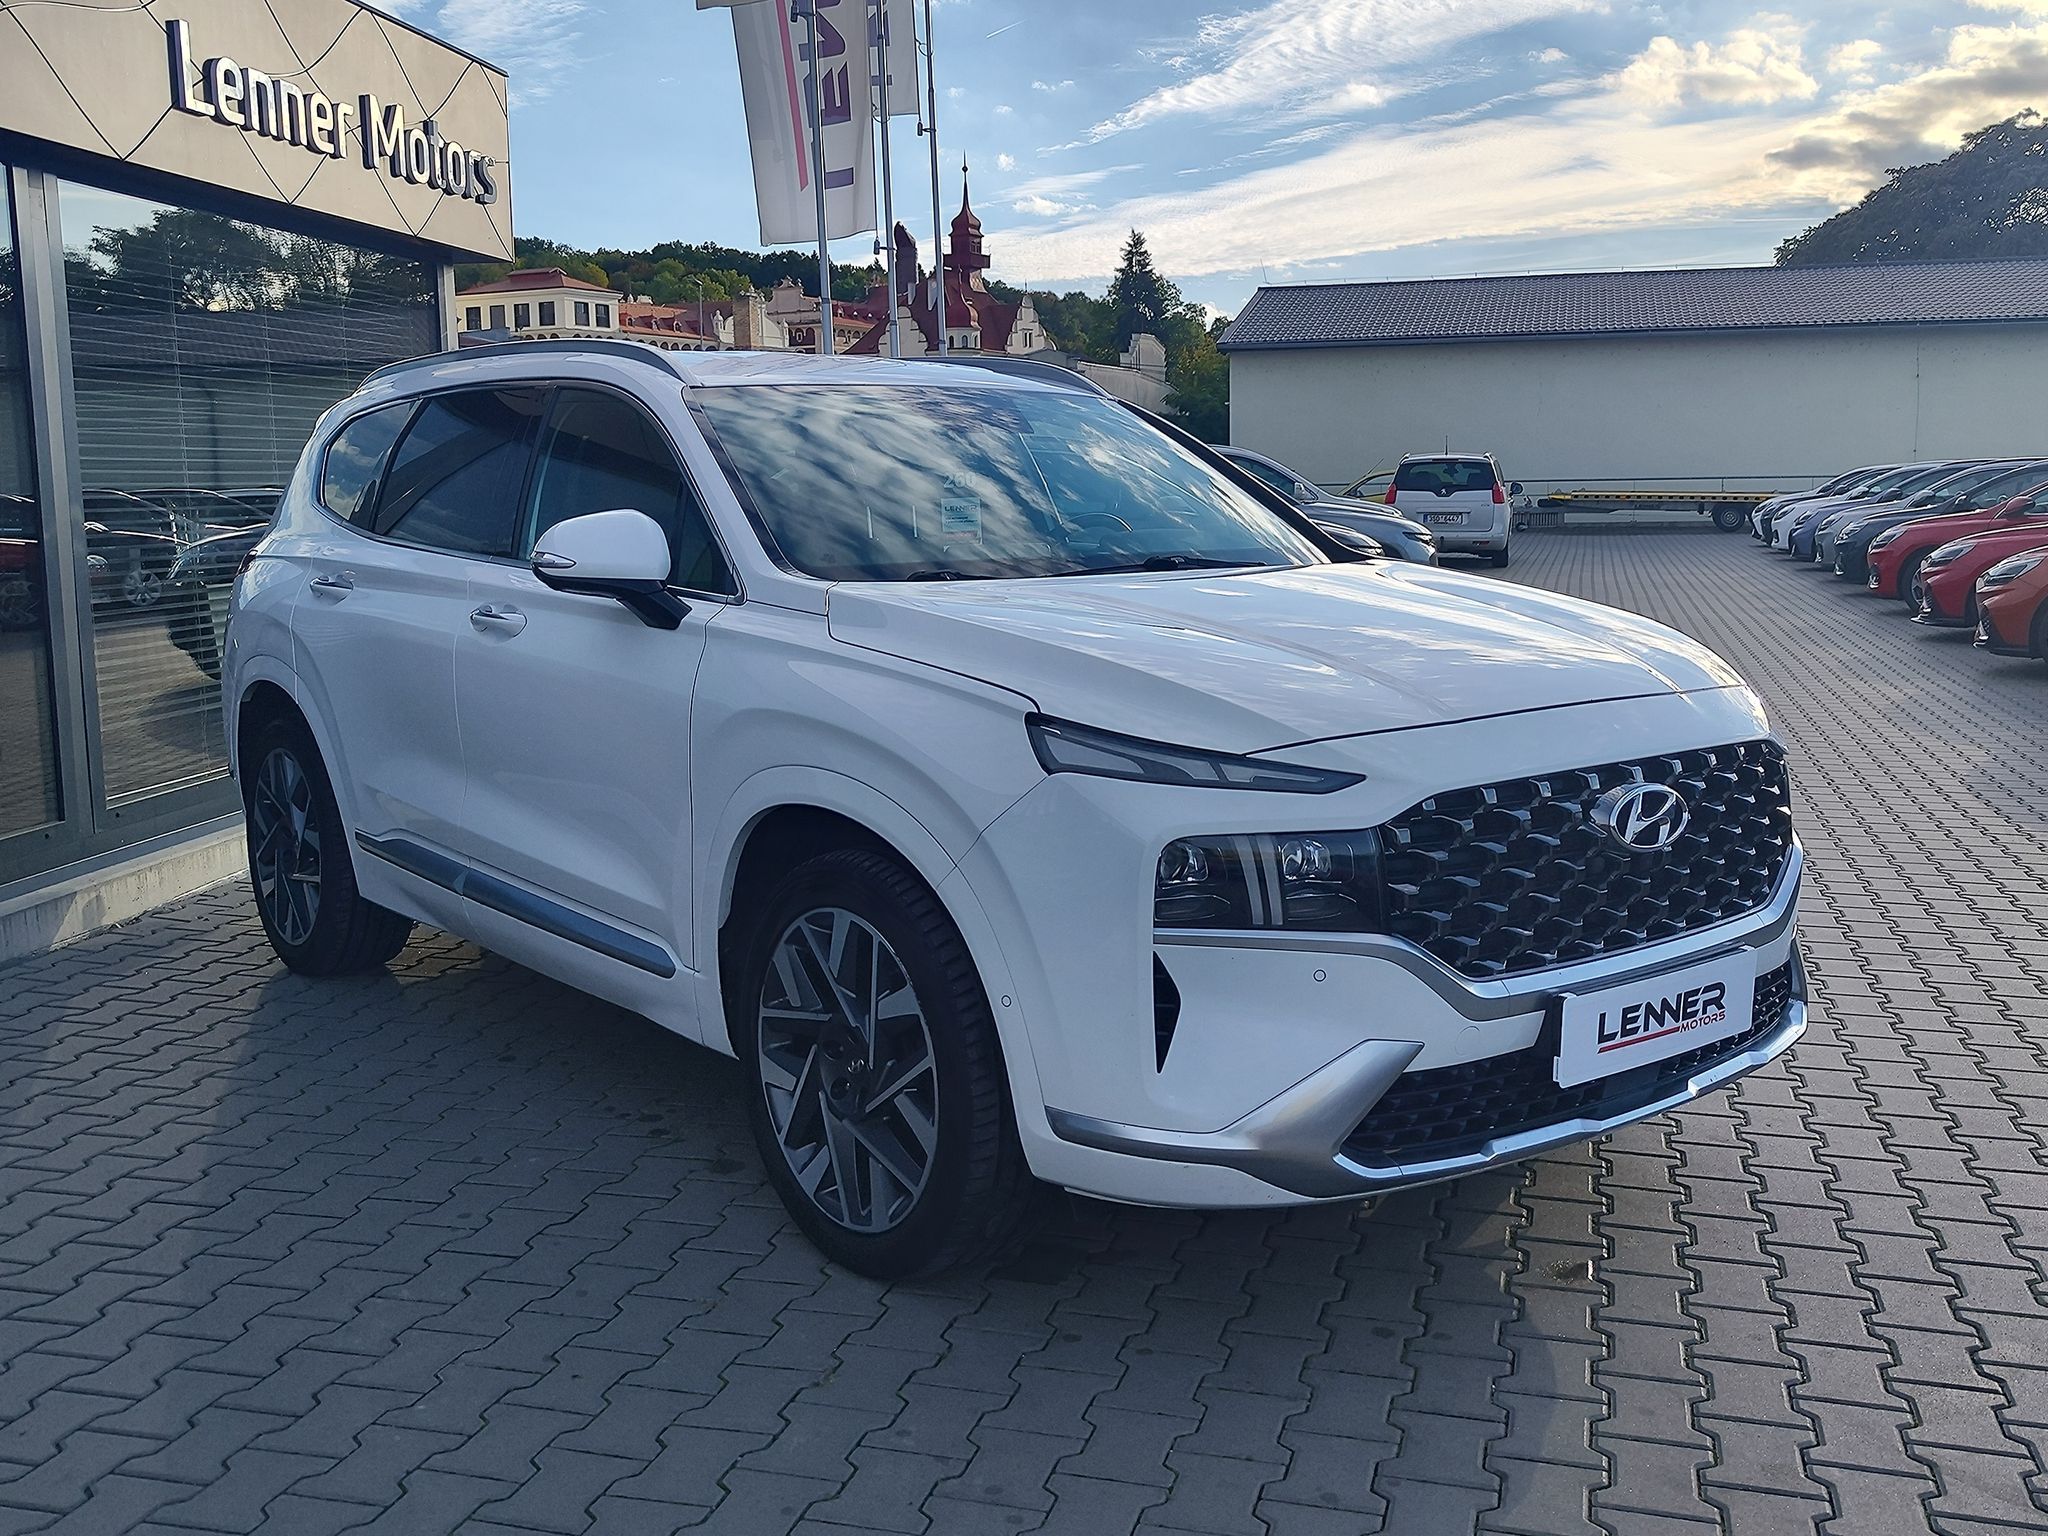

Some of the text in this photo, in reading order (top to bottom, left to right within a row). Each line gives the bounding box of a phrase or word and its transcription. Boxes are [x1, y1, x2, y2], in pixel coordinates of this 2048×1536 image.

[165, 19, 498, 204] Lenner Motors
[1597, 981, 1727, 1044] LENNER
[1680, 1010, 1727, 1034] MOTORS
